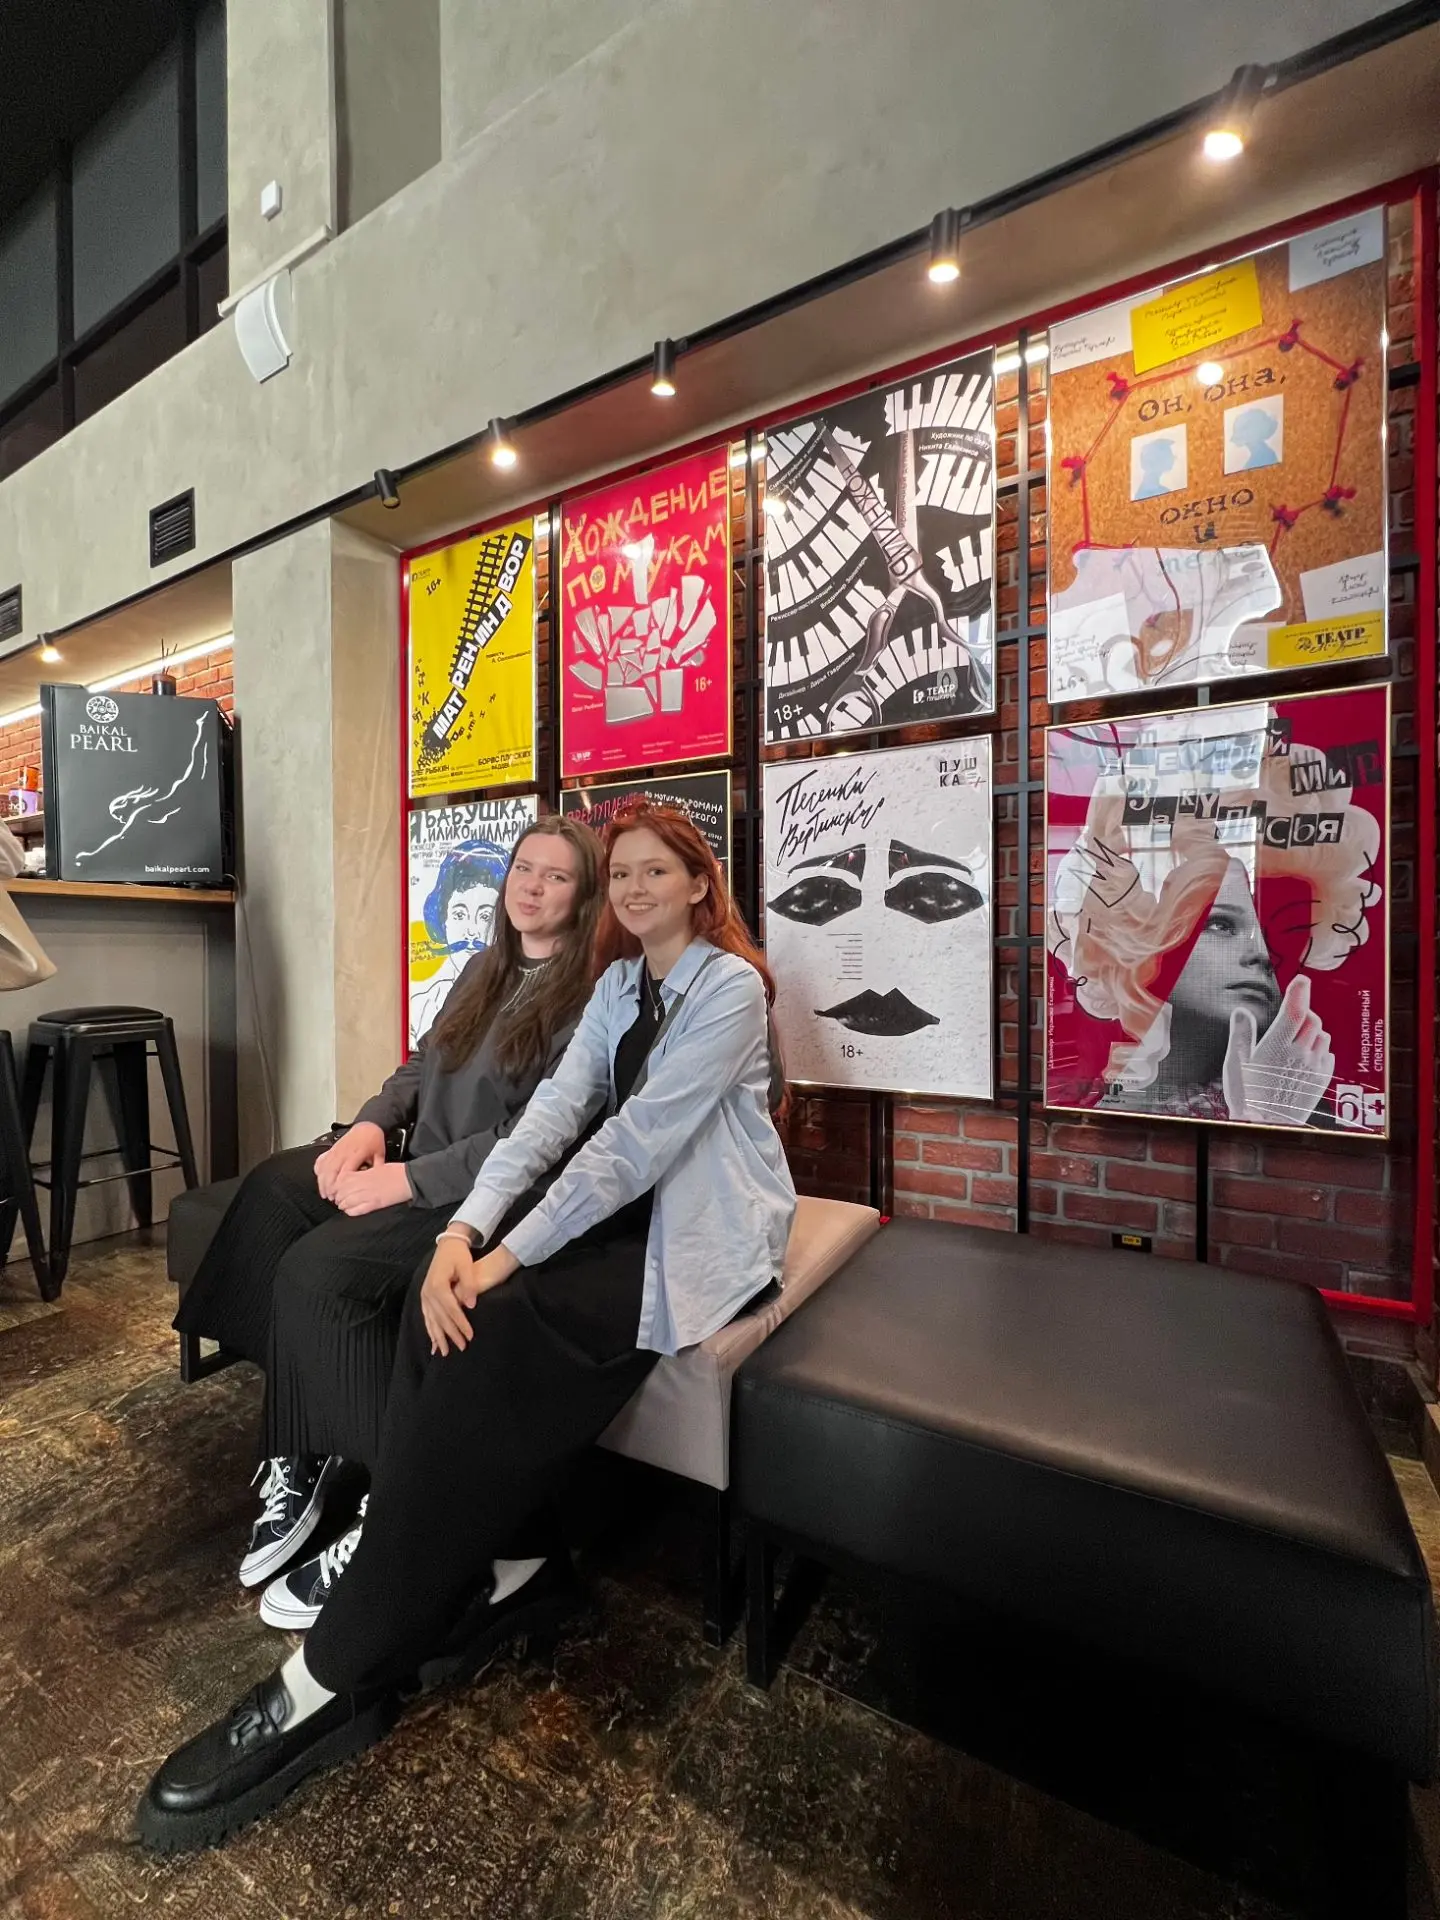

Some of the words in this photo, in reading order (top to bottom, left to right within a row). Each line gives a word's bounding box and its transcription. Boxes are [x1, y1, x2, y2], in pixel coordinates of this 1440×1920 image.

[562, 466, 728, 568] ХОЖДЕНИЕ
[841, 463, 923, 585] НОЖНИЦЫ
[567, 565, 606, 608] ПО
[1315, 627, 1365, 645] ТЕАТР
[927, 684, 956, 695] ТЕАТР
[773, 703, 803, 724] 18+
[80, 724, 127, 736] BAIKAL
[70, 733, 138, 753] PEARL
[940, 774, 960, 787] КА
[688, 799, 723, 814] РОМАНА
[428, 823, 470, 843] ИЛИКО
[144, 864, 210, 874] baikalpearl.com
[1358, 990, 1373, 1073] Интерактивный
[840, 1044, 864, 1058] 18+
[1373, 1018, 1384, 1072] спектакль
[1338, 1092, 1385, 1122] 6+
